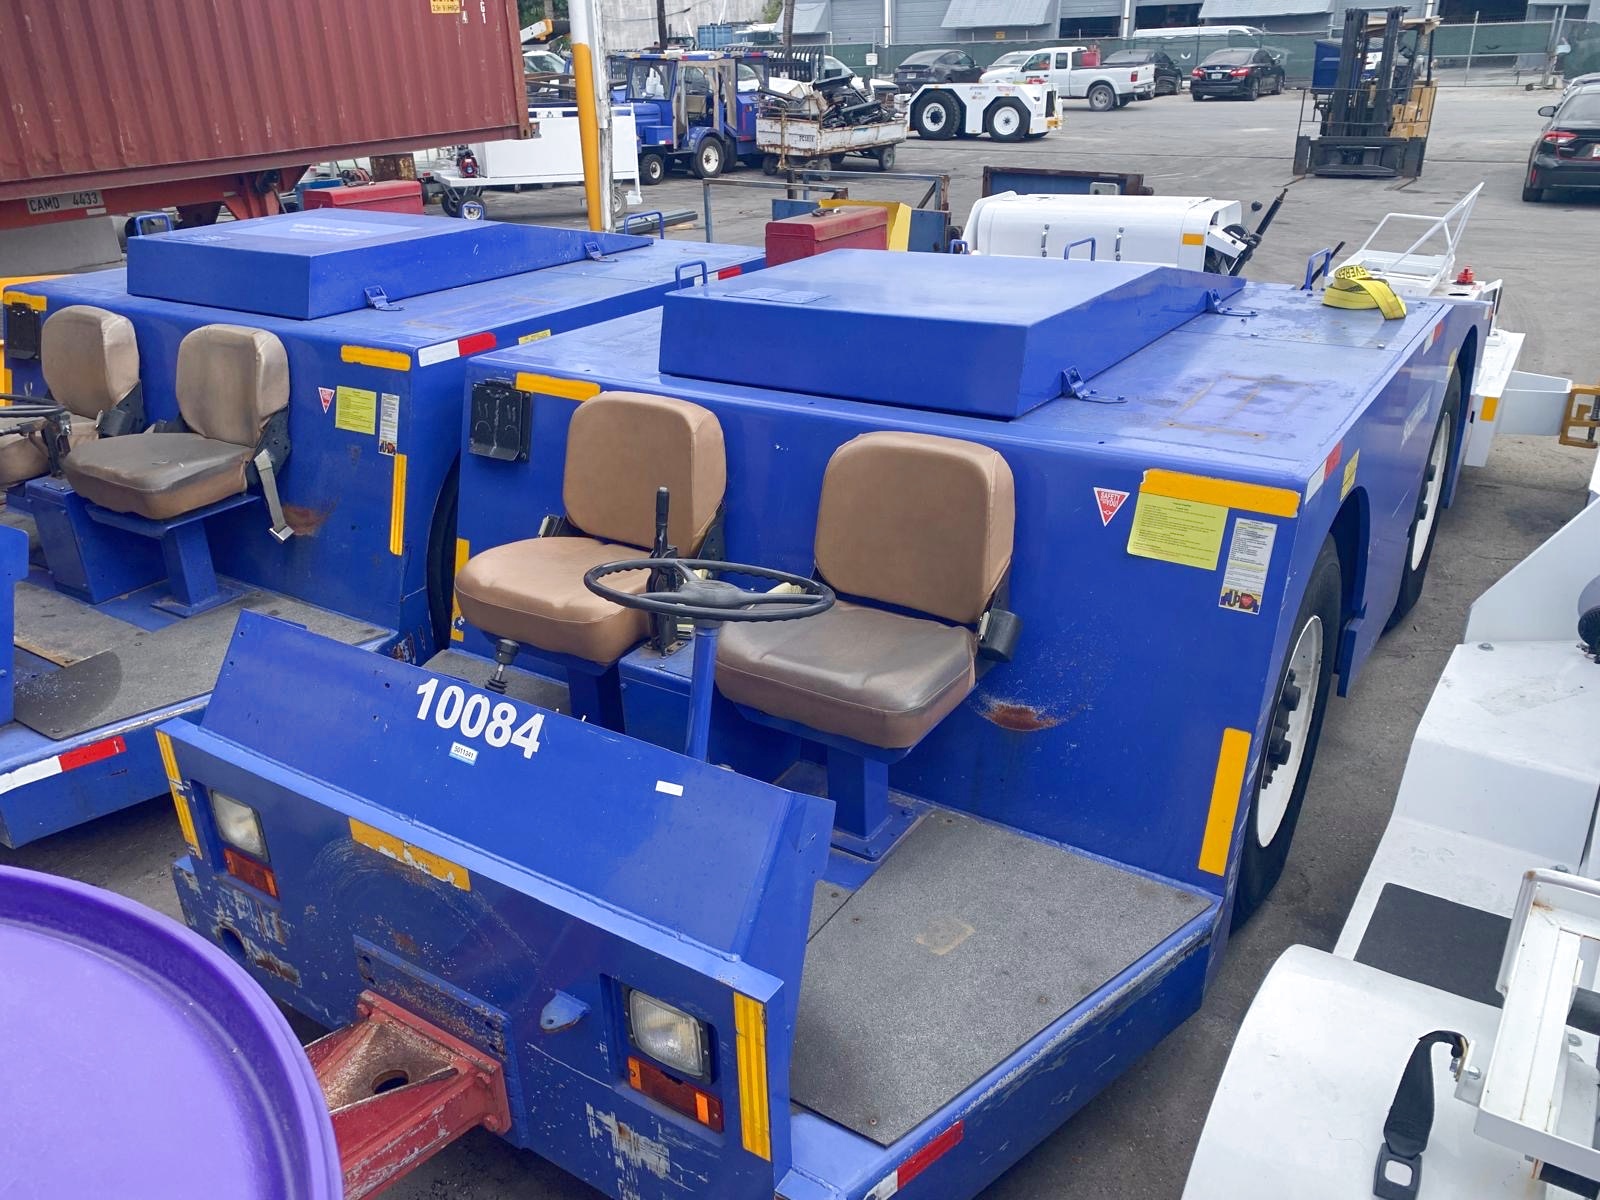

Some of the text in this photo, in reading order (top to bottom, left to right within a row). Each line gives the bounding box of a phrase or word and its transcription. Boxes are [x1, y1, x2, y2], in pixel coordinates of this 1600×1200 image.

[72, 191, 98, 205] 4433
[1100, 491, 1120, 501] SAFETY
[416, 677, 545, 760] 10084
